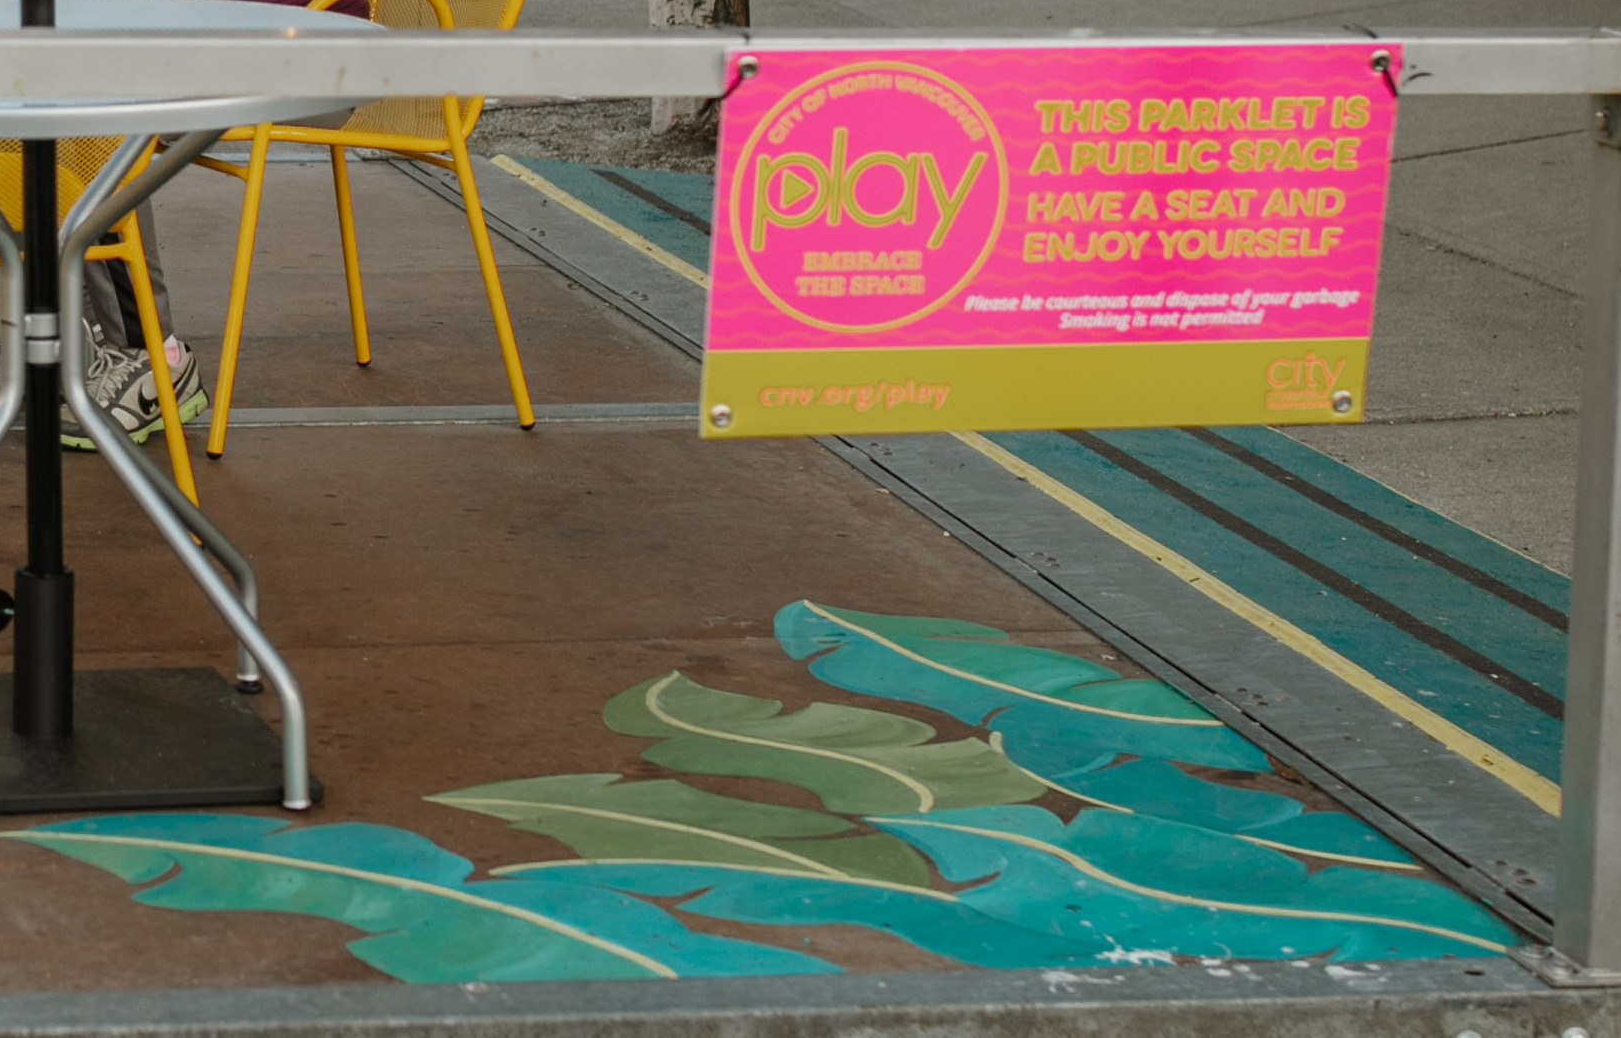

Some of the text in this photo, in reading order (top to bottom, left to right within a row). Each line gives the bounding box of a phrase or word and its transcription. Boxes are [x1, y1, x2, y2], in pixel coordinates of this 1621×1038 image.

[768, 73, 986, 145] CITY OF NORTH VANCOUVER
[1034, 95, 1372, 134] THIS PARKLET IS
[1028, 136, 1362, 176] A PUBLIC SPACE
[750, 126, 988, 252] play
[1026, 186, 1347, 223] HAVE A SEAT AND
[802, 250, 923, 273] EMBRACE
[1022, 226, 1345, 263] ENJOY YOURSELF
[794, 274, 926, 297] THE SPACE
[964, 288, 1361, 312] Please be courteous and dispose of your garbage
[1058, 308, 1266, 332] Smoking is not permitted
[1265, 349, 1347, 398] city
[759, 379, 952, 413] cnv.org/play
